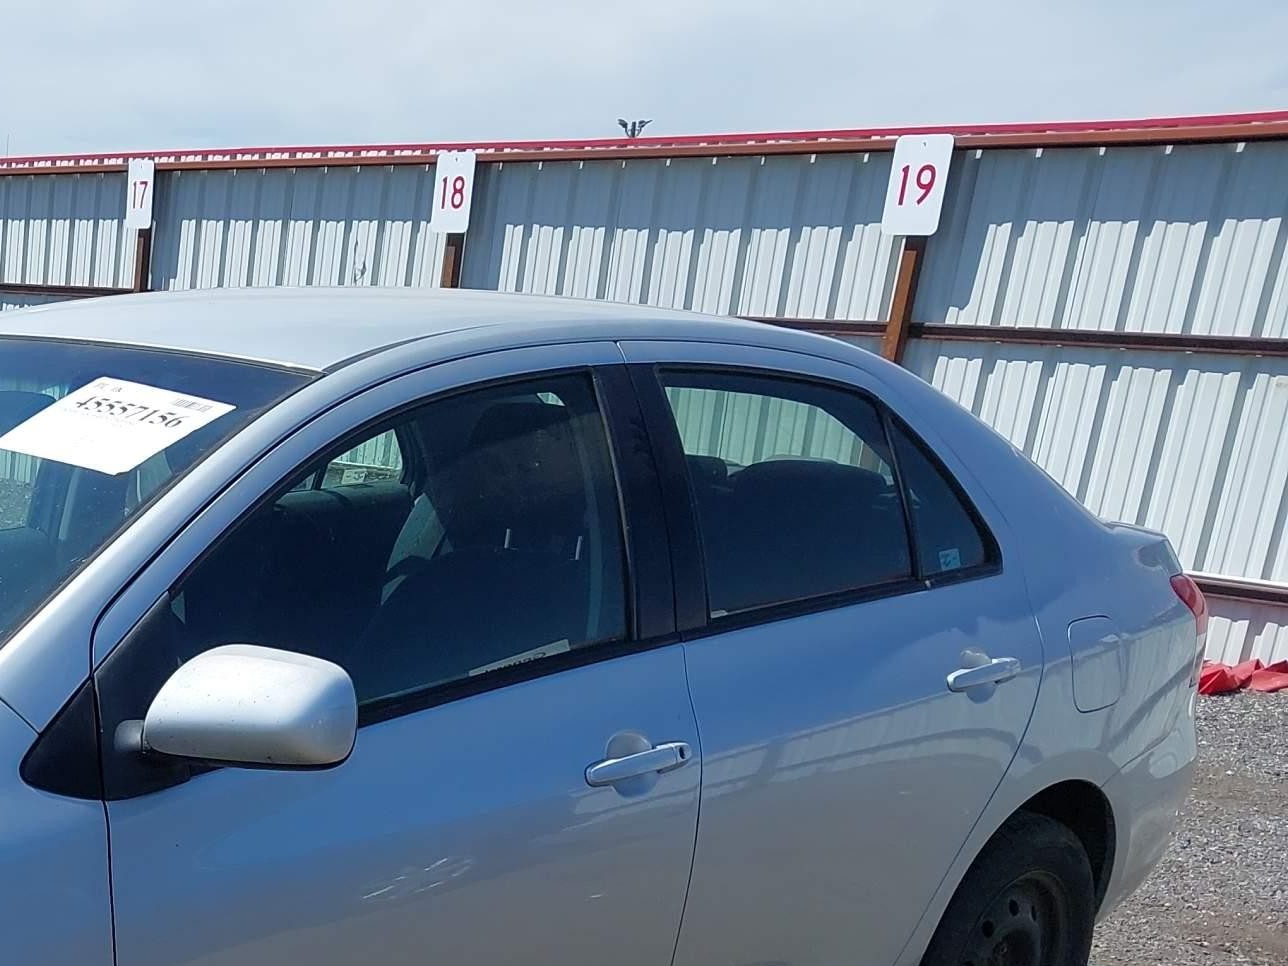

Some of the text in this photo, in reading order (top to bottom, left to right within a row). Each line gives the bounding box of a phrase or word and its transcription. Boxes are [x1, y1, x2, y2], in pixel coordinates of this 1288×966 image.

[132, 180, 149, 209] 17
[441, 176, 465, 210] 18
[898, 164, 937, 206] 19
[75, 396, 189, 429] 45557156
